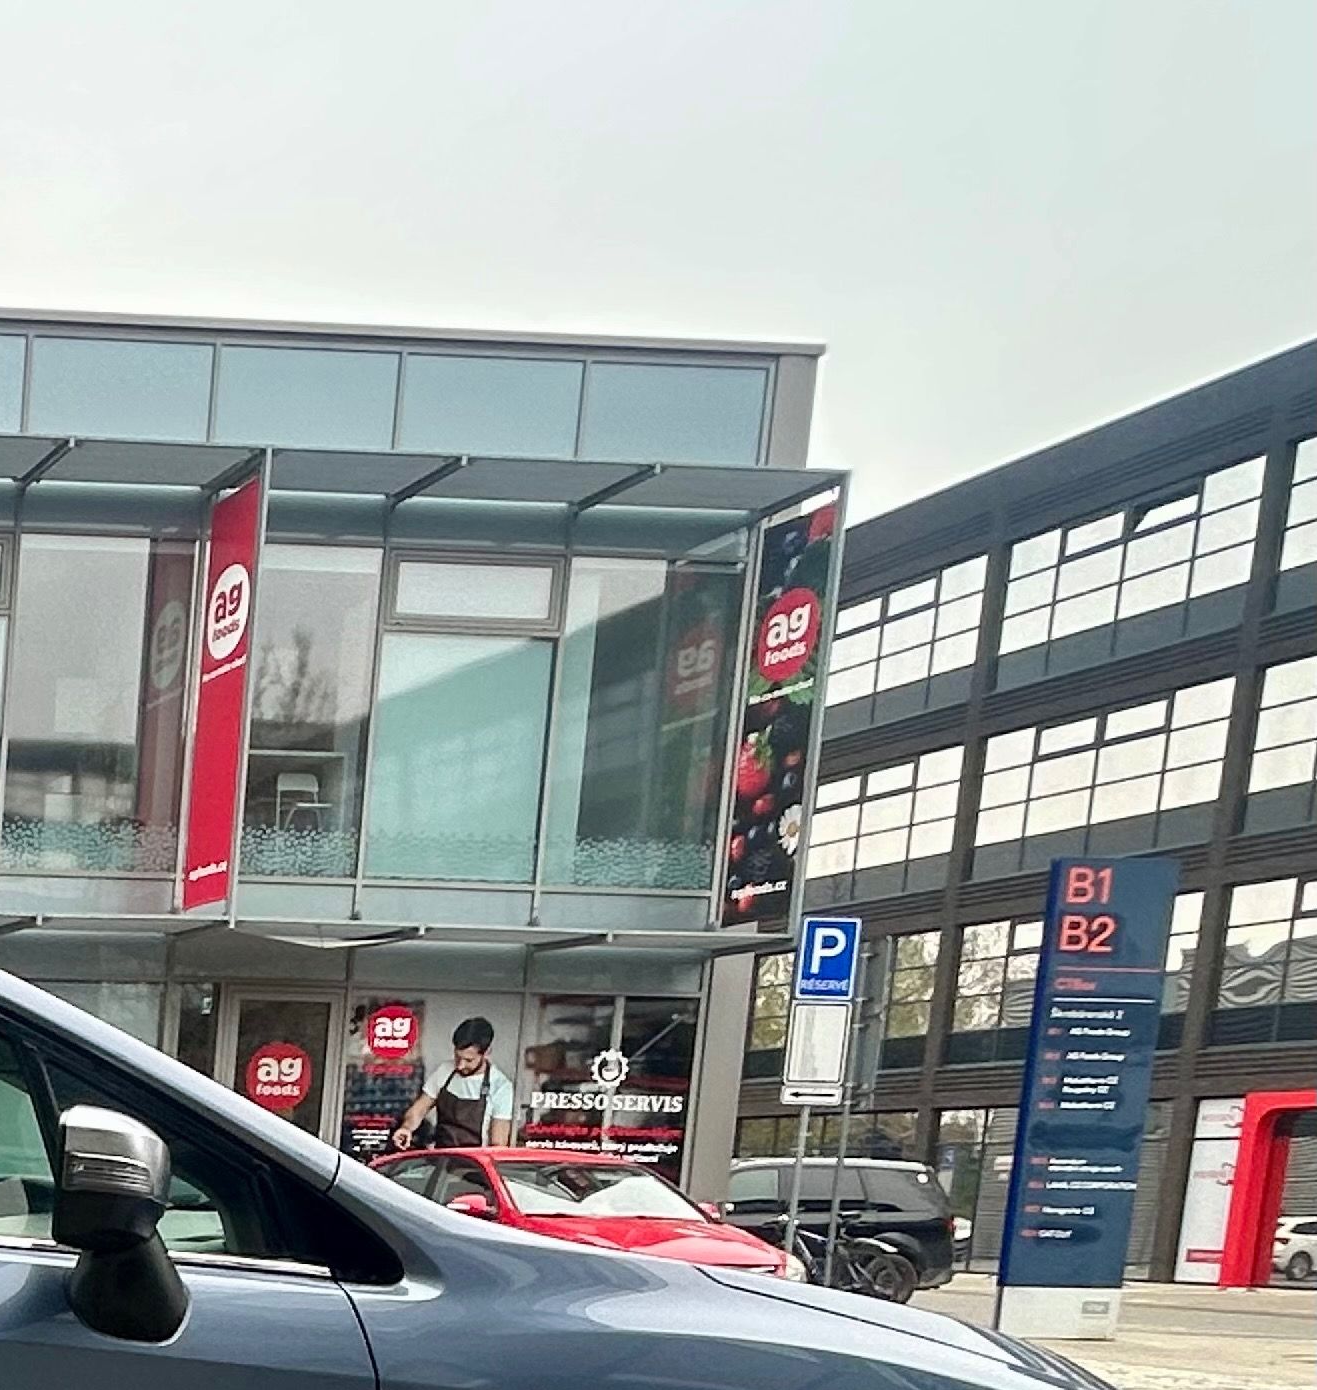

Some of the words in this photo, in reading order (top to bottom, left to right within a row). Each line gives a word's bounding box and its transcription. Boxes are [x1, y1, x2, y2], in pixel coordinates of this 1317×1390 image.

[215, 581, 243, 624] ag
[766, 603, 812, 648] ag
[764, 640, 808, 667] foods
[1067, 866, 1113, 904] B1
[1059, 915, 1117, 953] B2
[810, 927, 847, 975] P
[374, 1017, 412, 1038] ag
[257, 1057, 303, 1083] ag
[256, 1083, 301, 1097] foods
[530, 1092, 608, 1111] PRESSO
[612, 1094, 684, 1113] SERVIS
